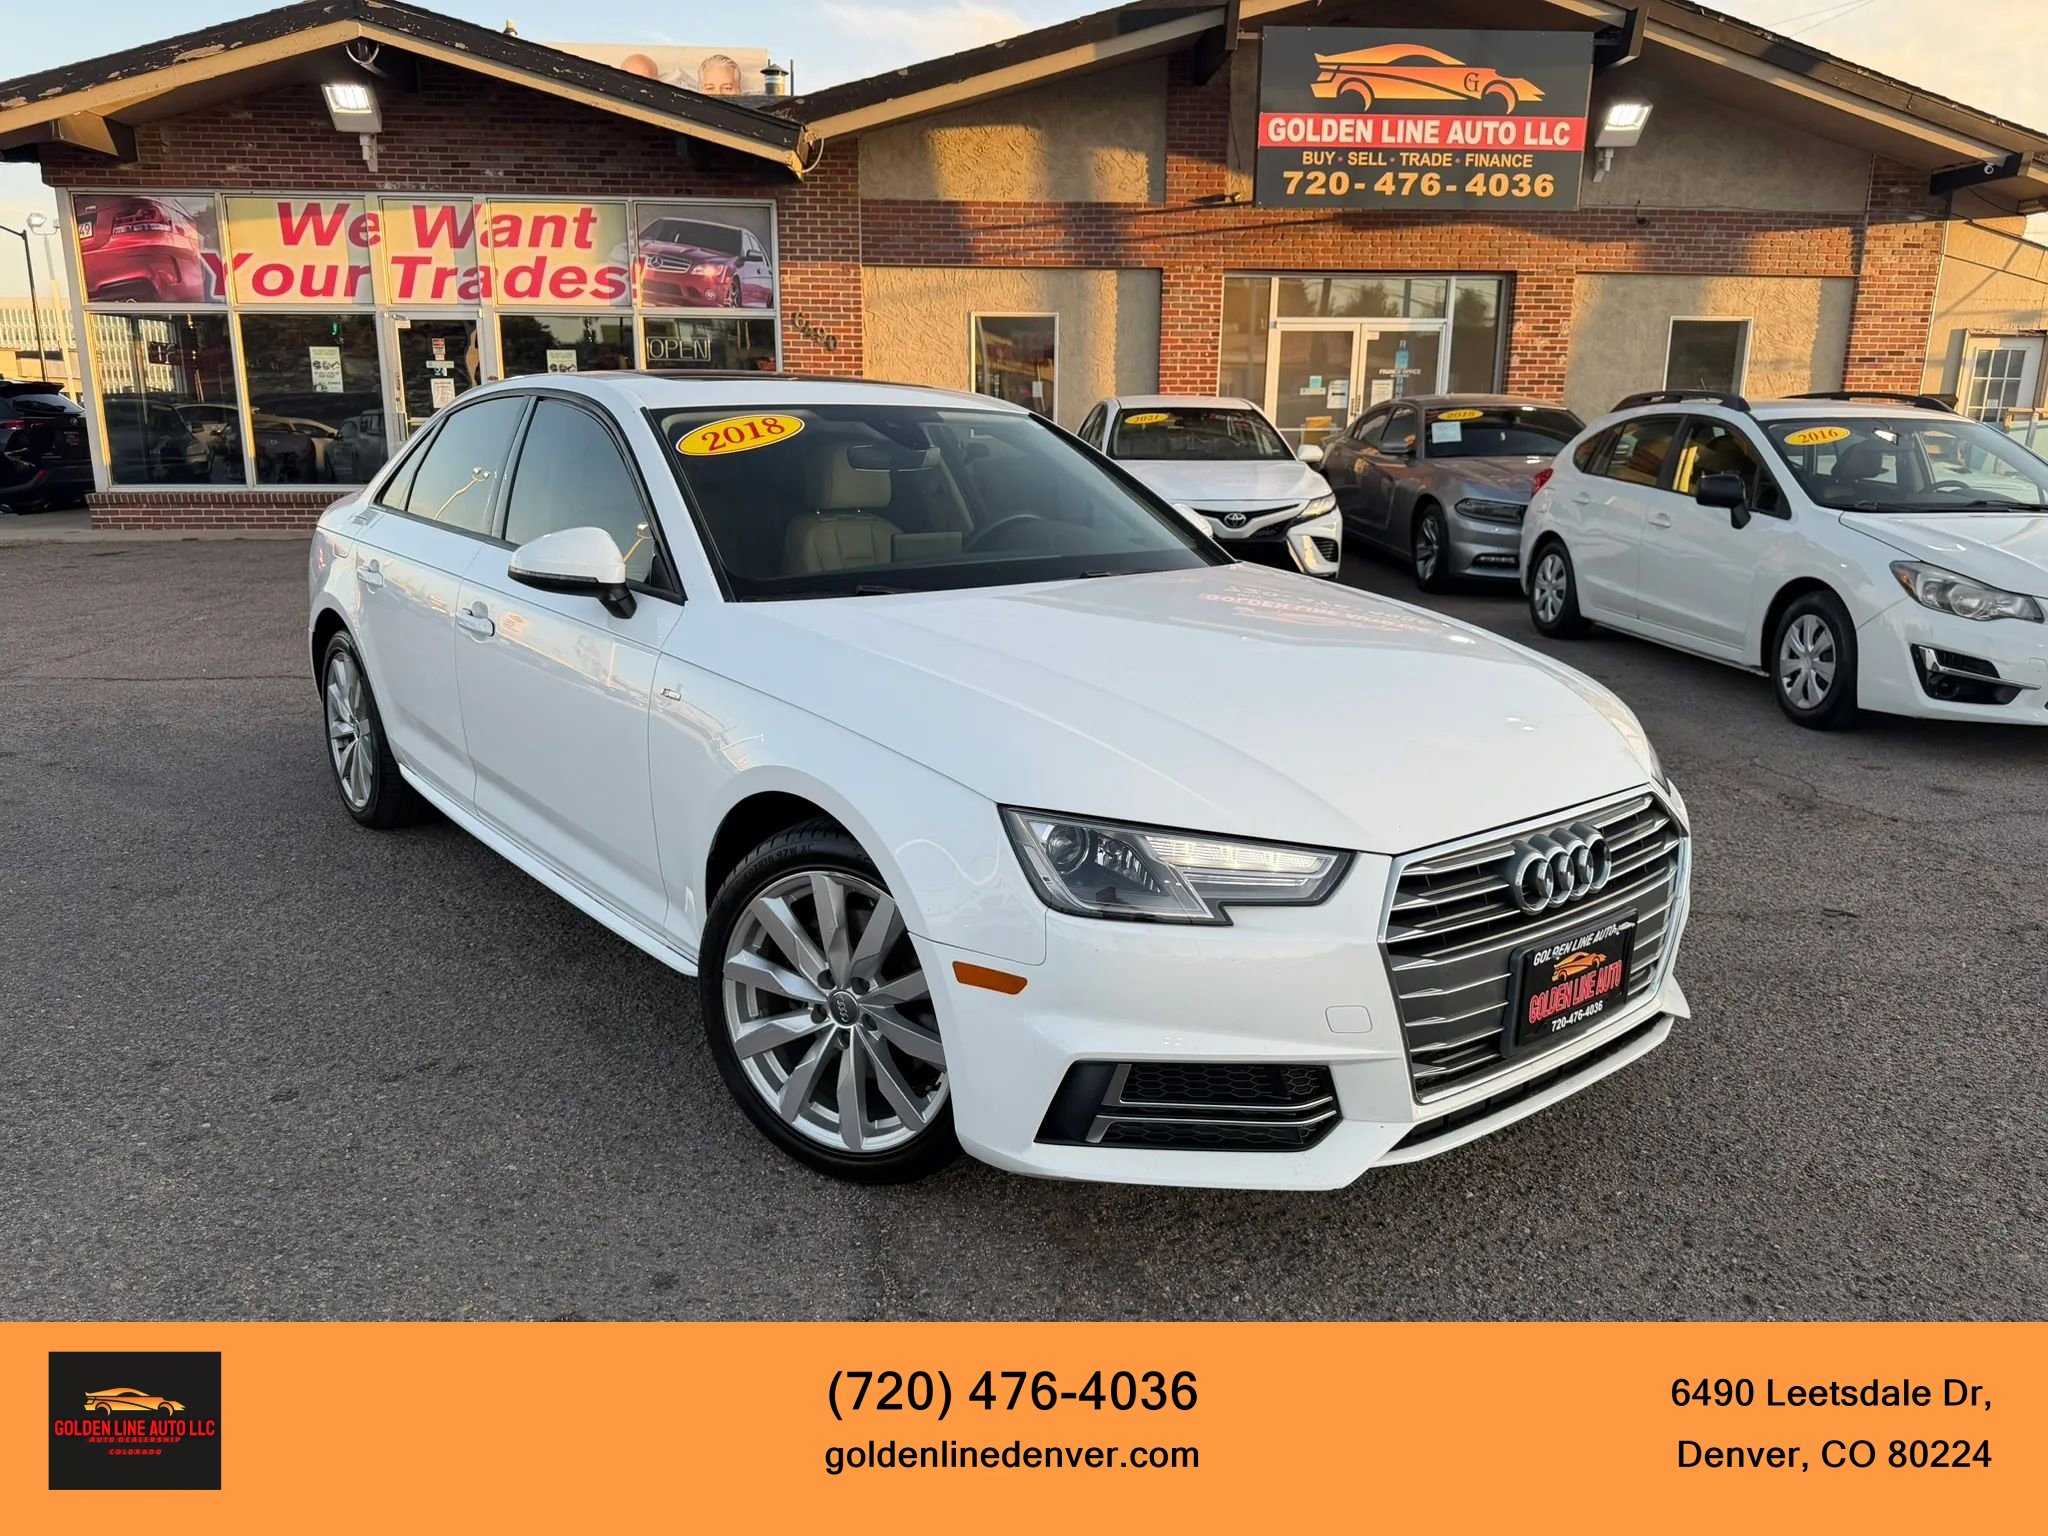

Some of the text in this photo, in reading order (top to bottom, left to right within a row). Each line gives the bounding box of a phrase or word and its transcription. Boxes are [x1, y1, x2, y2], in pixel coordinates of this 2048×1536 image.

[1463, 72, 1480, 93] G
[1267, 117, 1570, 146] GOLDEN LINE AUTO LLC
[1302, 151, 1533, 168] BUY SELL TRADE FINANCE
[277, 201, 597, 249] We Want
[201, 252, 371, 298] Your
[649, 339, 708, 360] OPEN
[701, 417, 785, 452] 2018
[1799, 428, 1838, 444] 2016
[1571, 933, 1595, 951] LINE
[1529, 959, 1623, 1024] GOLDEN LINE AUTO
[1551, 1000, 1604, 1032] 720-476-4036
